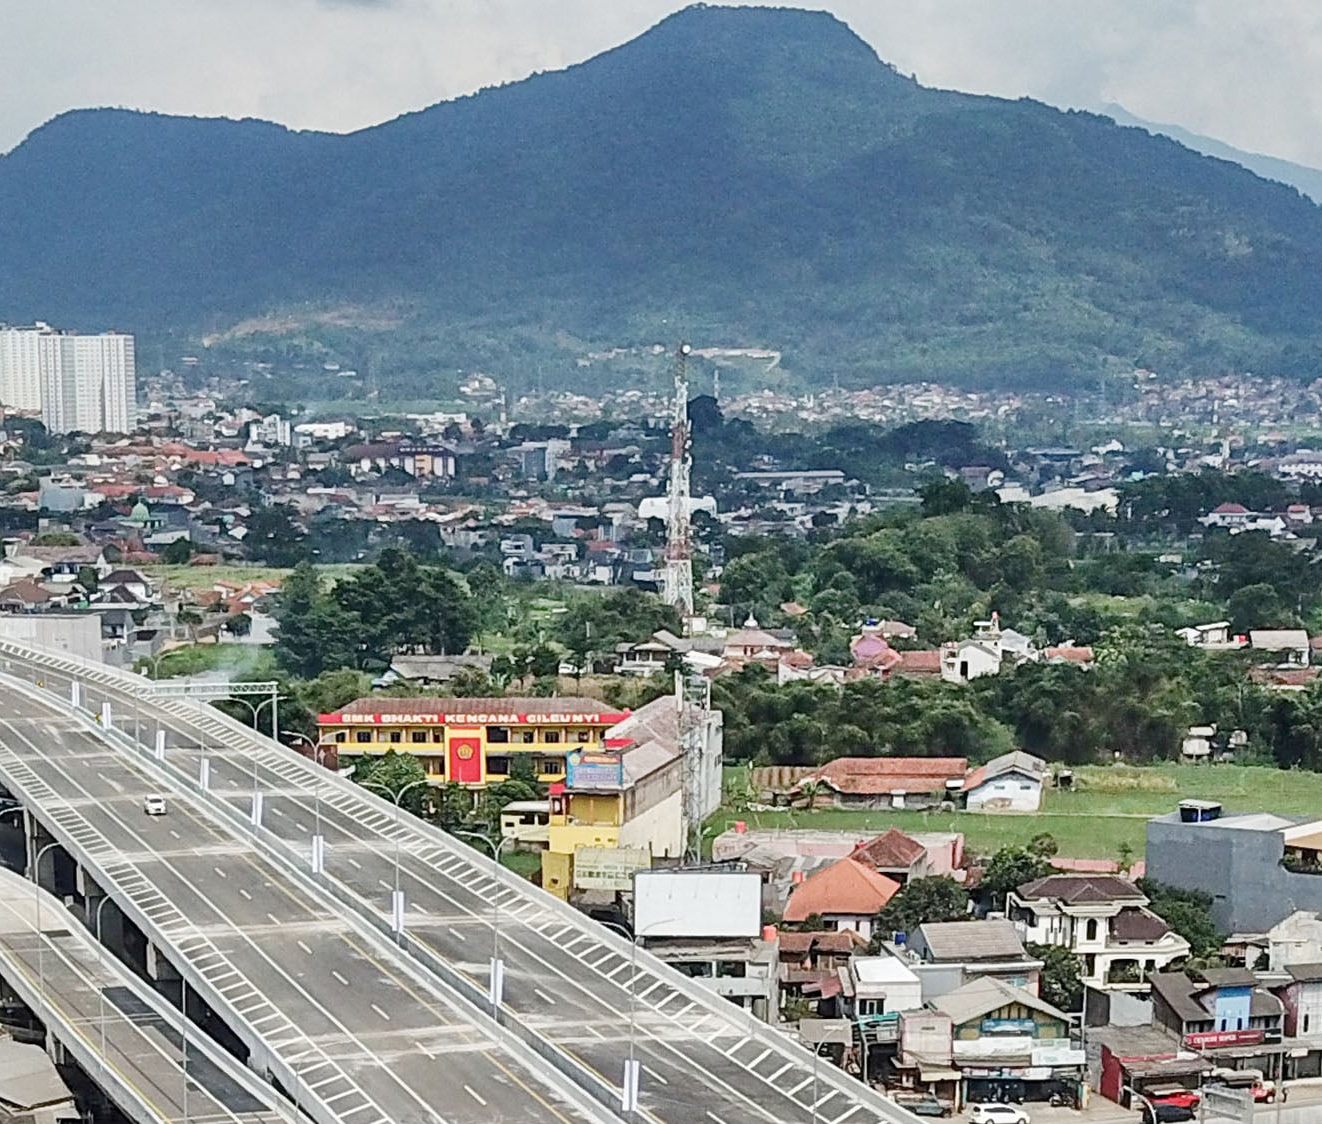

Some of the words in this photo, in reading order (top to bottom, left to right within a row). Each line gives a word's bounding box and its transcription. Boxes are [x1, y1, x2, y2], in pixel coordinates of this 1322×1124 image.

[380, 713, 439, 723] BHAKTI
[444, 713, 519, 723] KENCANA
[526, 713, 600, 723] CILEUNYI
